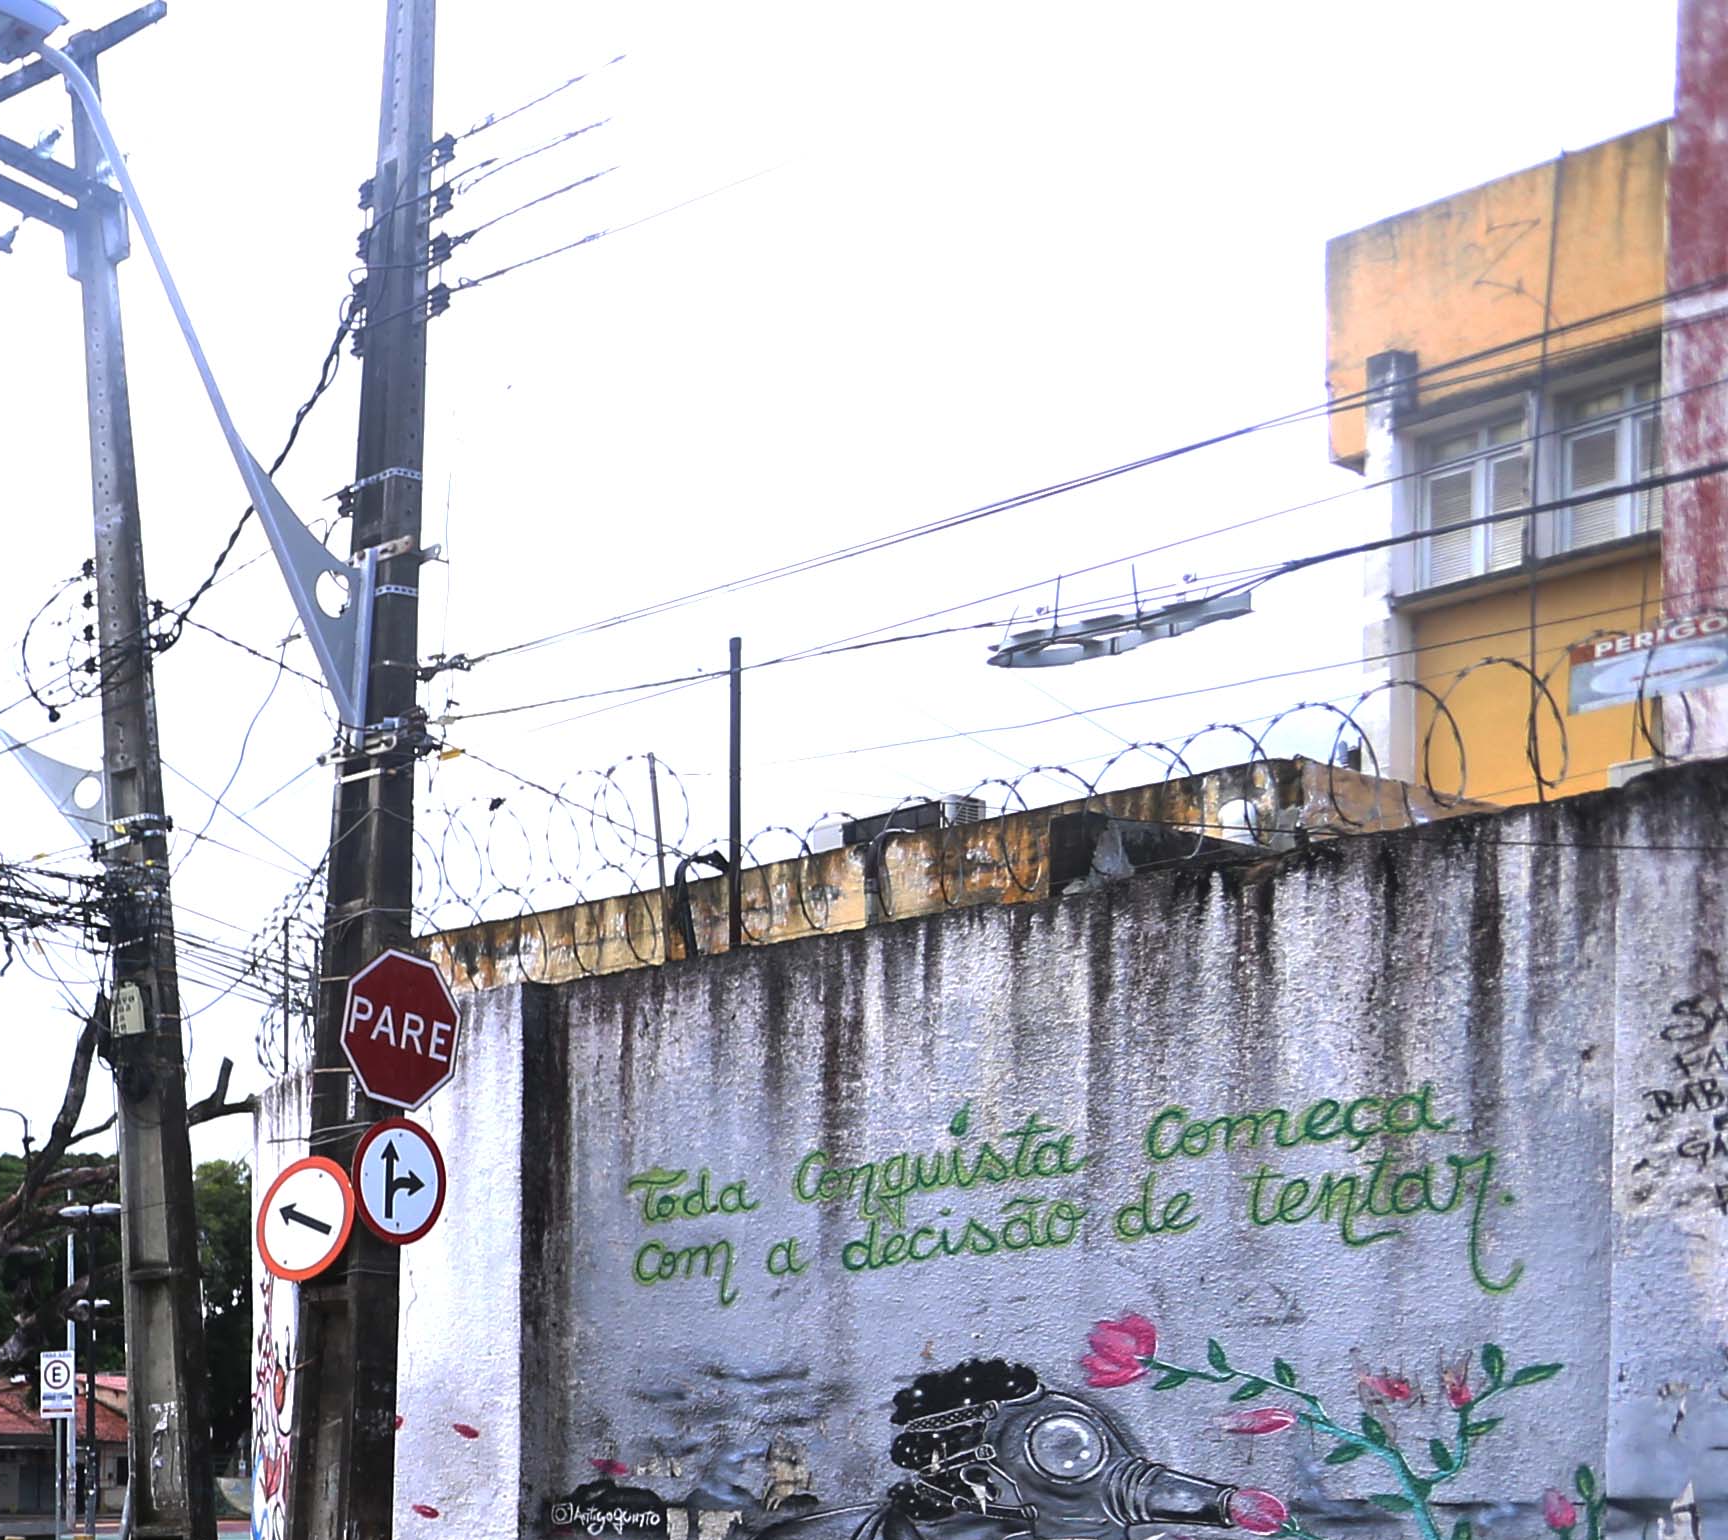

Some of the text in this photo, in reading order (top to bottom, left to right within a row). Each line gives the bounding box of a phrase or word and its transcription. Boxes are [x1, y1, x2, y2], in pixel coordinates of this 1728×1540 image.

[1595, 615, 1728, 658] PERIGO
[348, 994, 452, 1063] PARE
[627, 1168, 760, 1224] Toda
[765, 1237, 811, 1276] a
[843, 1197, 1093, 1272] decisão
[1114, 1170, 1202, 1243] de
[53, 1366, 62, 1383] E
